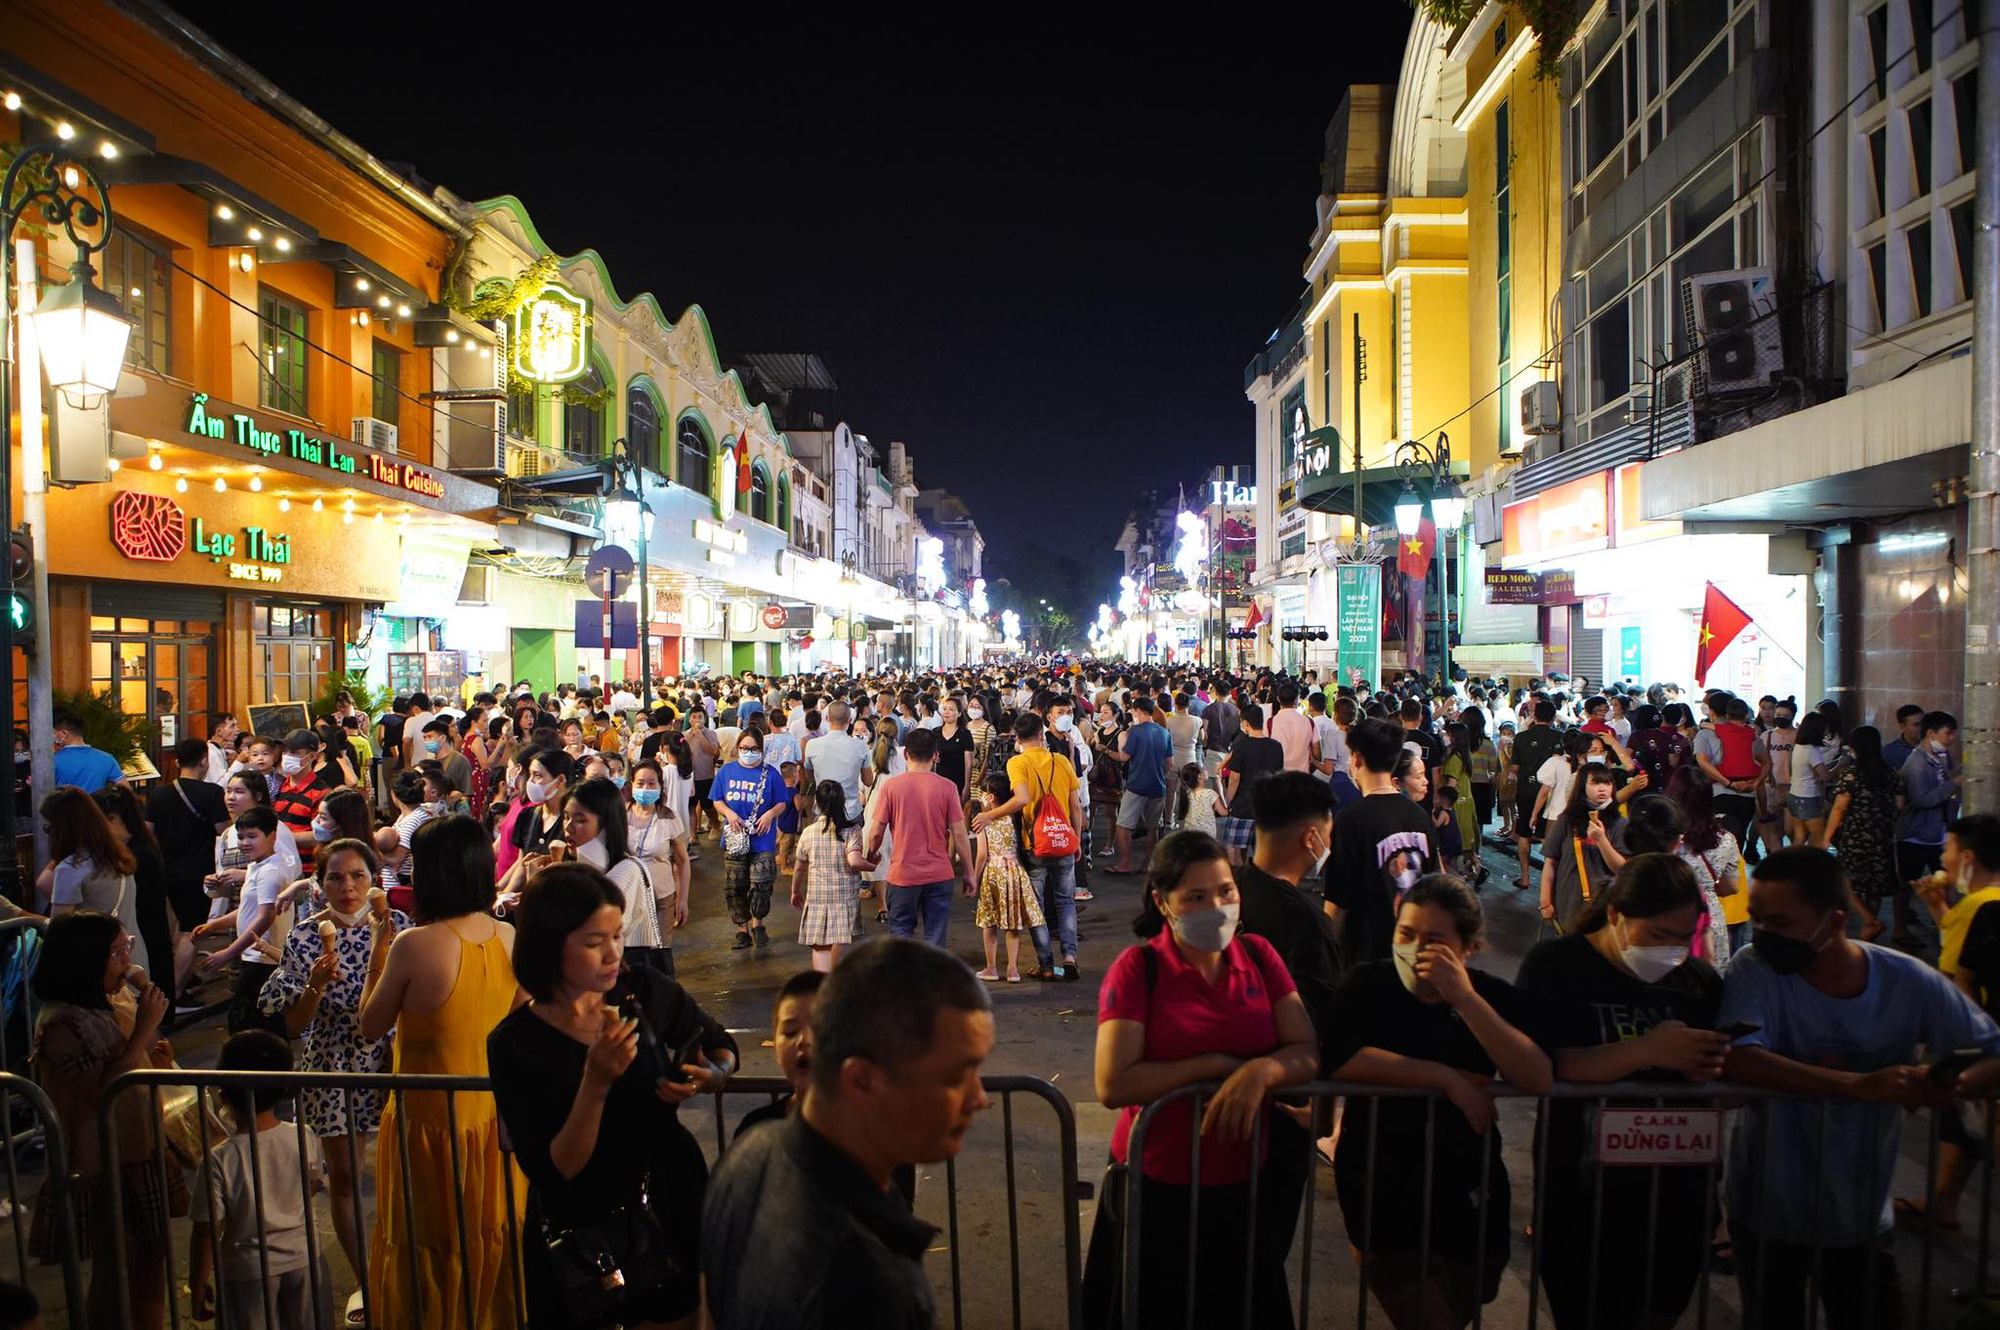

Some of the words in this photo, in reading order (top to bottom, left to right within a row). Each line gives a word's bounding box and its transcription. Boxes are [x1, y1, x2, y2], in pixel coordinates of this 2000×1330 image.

[189, 393, 225, 439] Ẩm
[233, 414, 281, 457] Thực
[289, 430, 322, 464] Thái
[329, 442, 355, 474] Lan
[370, 454, 399, 485] Thai
[405, 464, 445, 498] Cuisine
[196, 517, 235, 563] Lạc
[246, 526, 291, 563] Thái
[229, 562, 259, 581] SINCE
[1487, 574, 1508, 583] RED
[1341, 624, 1356, 633] VIỆT
[1348, 635, 1367, 643] 2021
[1607, 1127, 1671, 1150] DỪNG
[1675, 1134, 1712, 1153] LẠI
